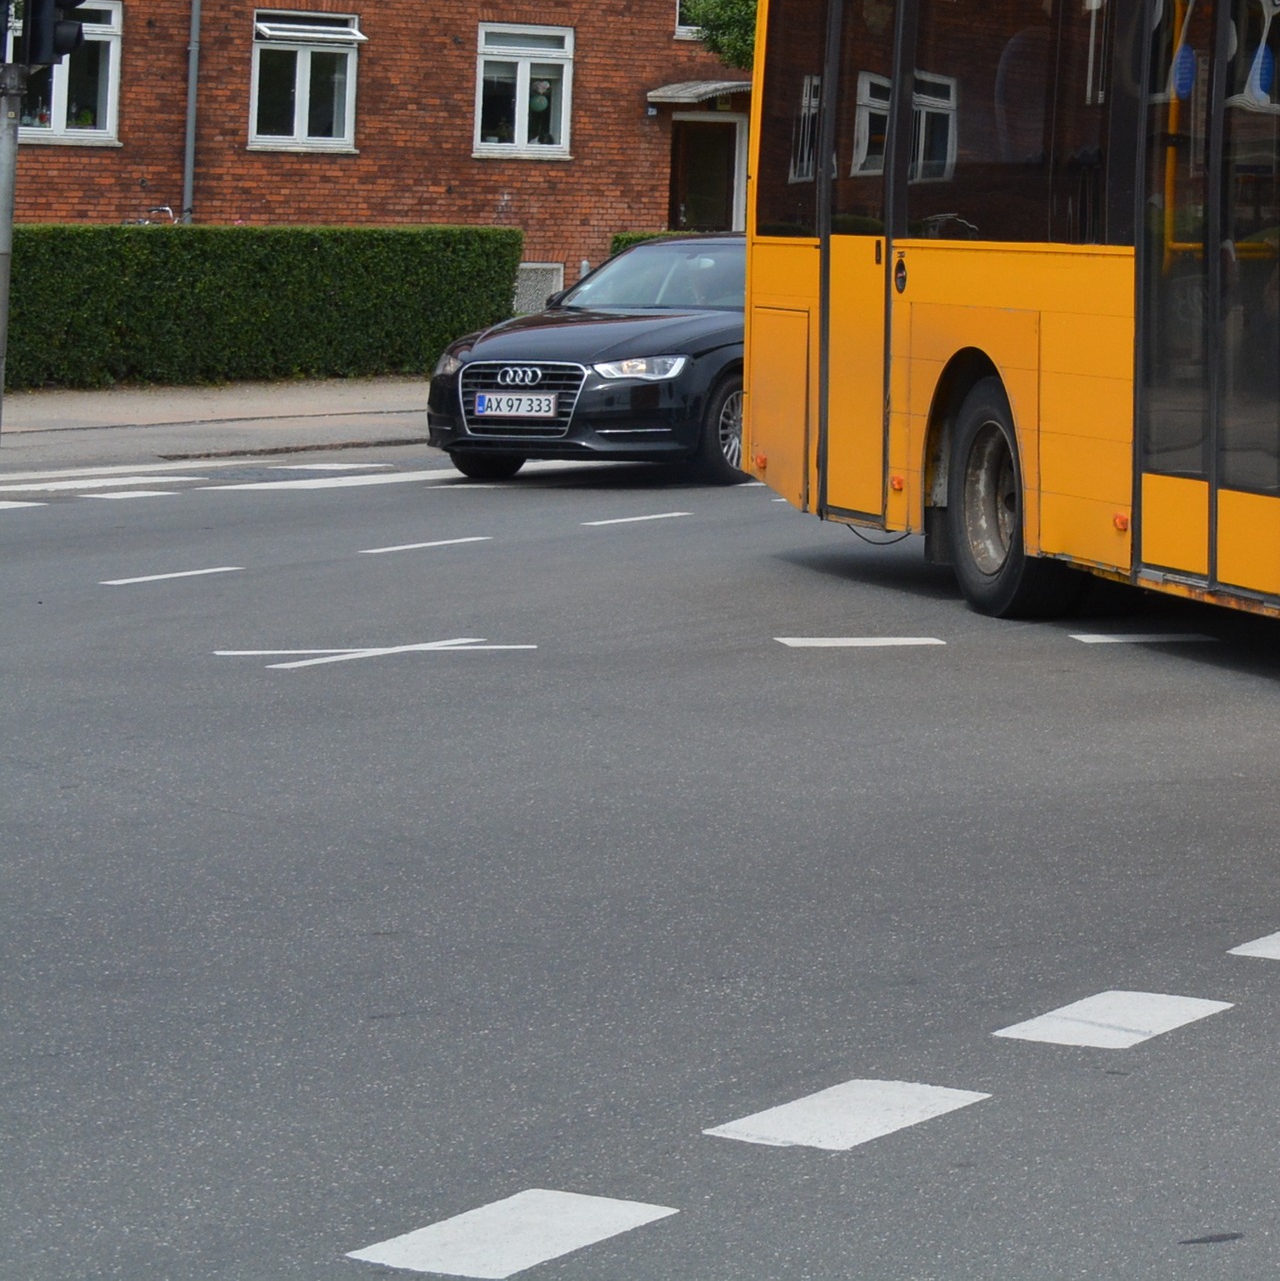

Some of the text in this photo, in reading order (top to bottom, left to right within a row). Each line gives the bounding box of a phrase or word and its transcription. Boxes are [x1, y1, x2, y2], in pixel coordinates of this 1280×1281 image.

[485, 397, 552, 413] AX 97 333
